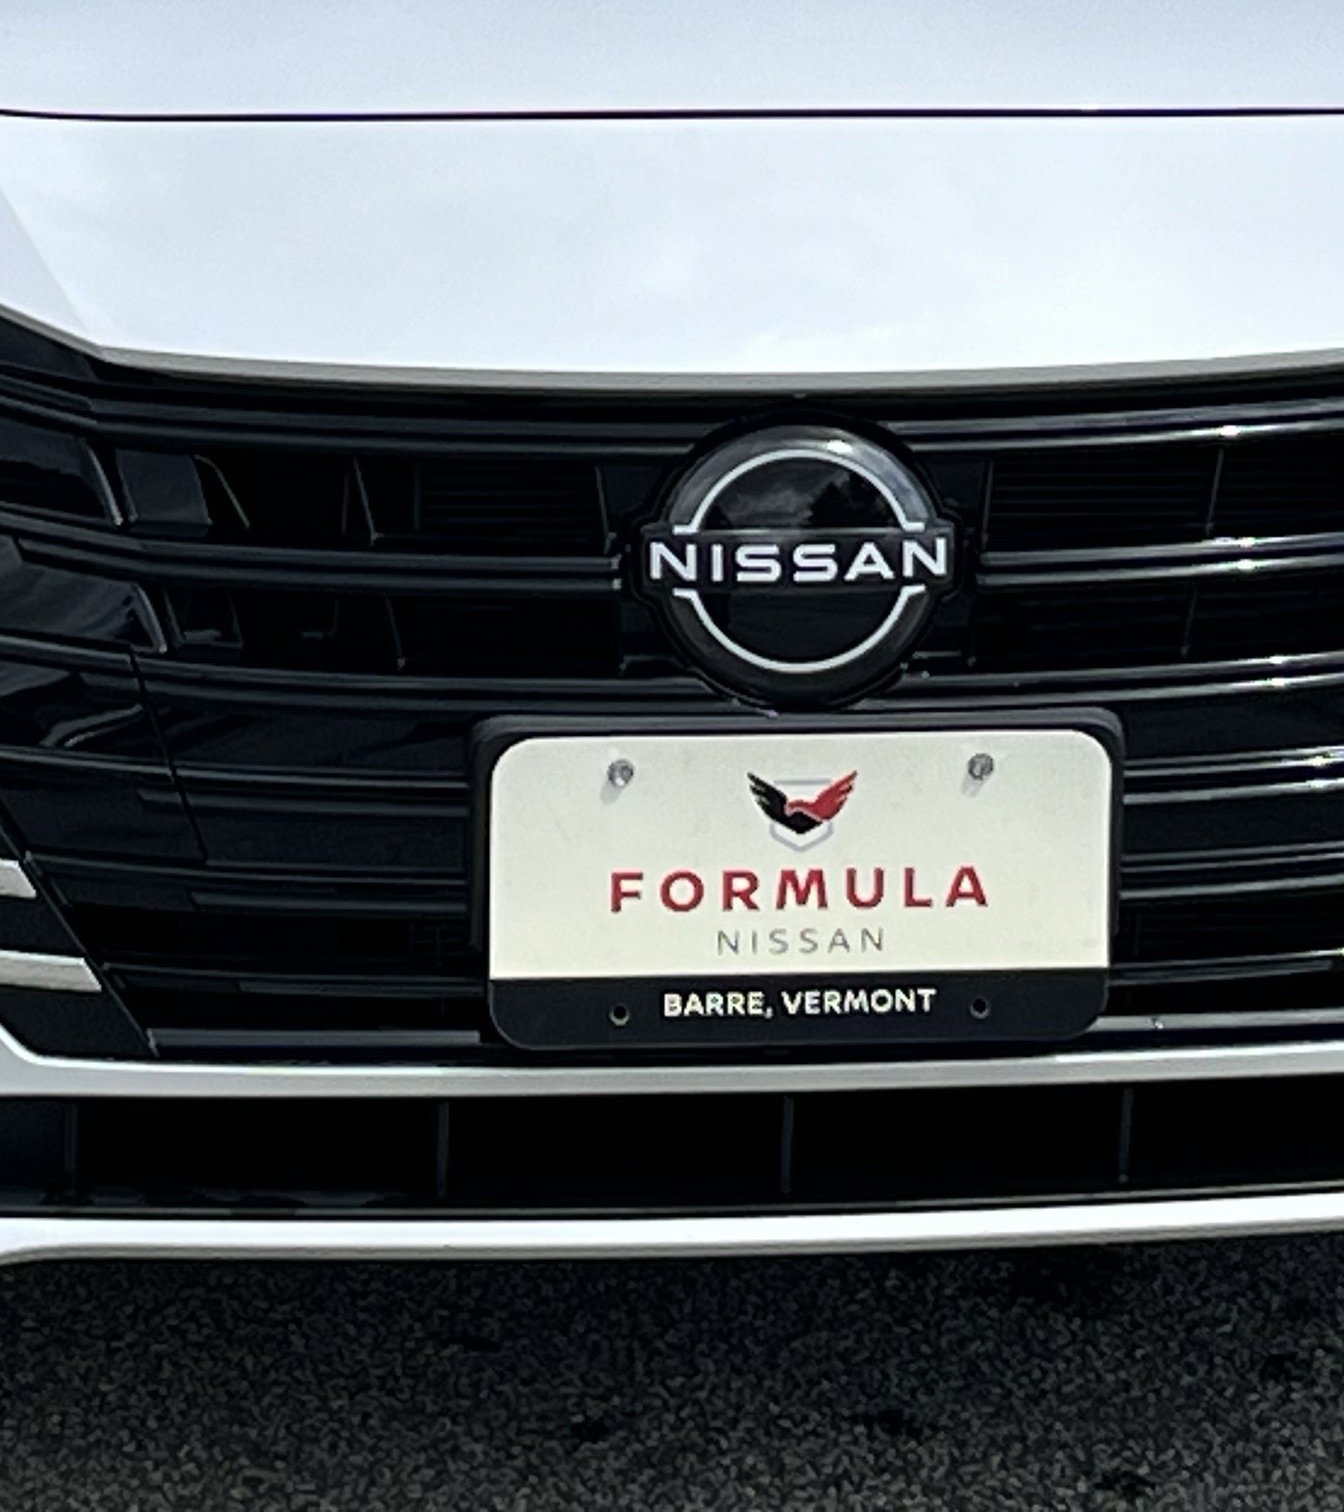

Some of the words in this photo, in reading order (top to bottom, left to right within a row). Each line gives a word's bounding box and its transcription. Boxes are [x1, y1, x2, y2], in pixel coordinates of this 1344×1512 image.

[649, 537, 947, 583] NISSAN
[609, 865, 988, 912] FORMULA
[716, 926, 884, 955] NISSAN
[663, 991, 773, 1019] BARRE,
[781, 988, 937, 1015] VERMONT
